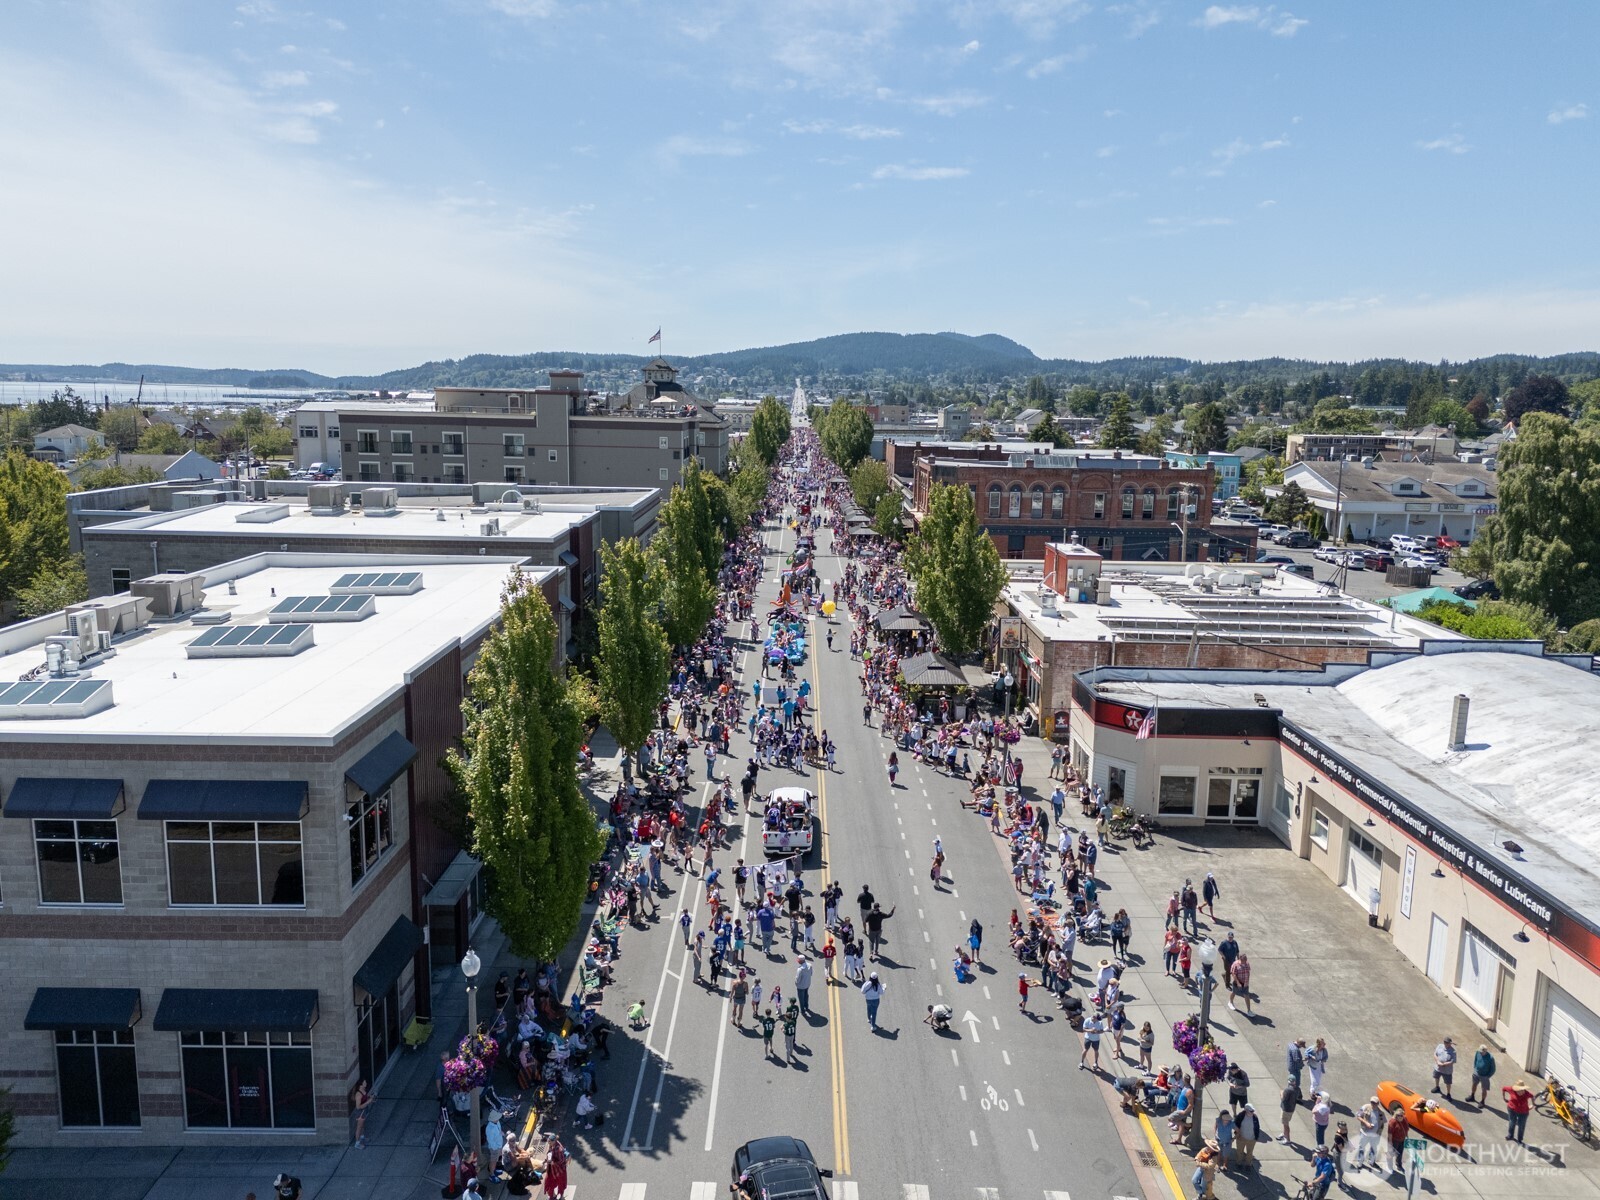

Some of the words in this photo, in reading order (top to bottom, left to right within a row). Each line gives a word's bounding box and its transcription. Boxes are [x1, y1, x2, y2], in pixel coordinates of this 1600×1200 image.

[1295, 781, 1303, 818] 310
[1282, 727, 1301, 746] Gasoline
[1303, 741, 1318, 759] Diesel
[1320, 753, 1337, 772] Pacific
[1338, 765, 1352, 782] Pride
[1355, 779, 1427, 836] Commercial/Residential
[1432, 831, 1466, 862] Industrial
[1467, 855, 1474, 869] &
[1475, 860, 1503, 887] Marine
[1504, 880, 1551, 922] Lubricants
[765, 1023, 773, 1031] 19
